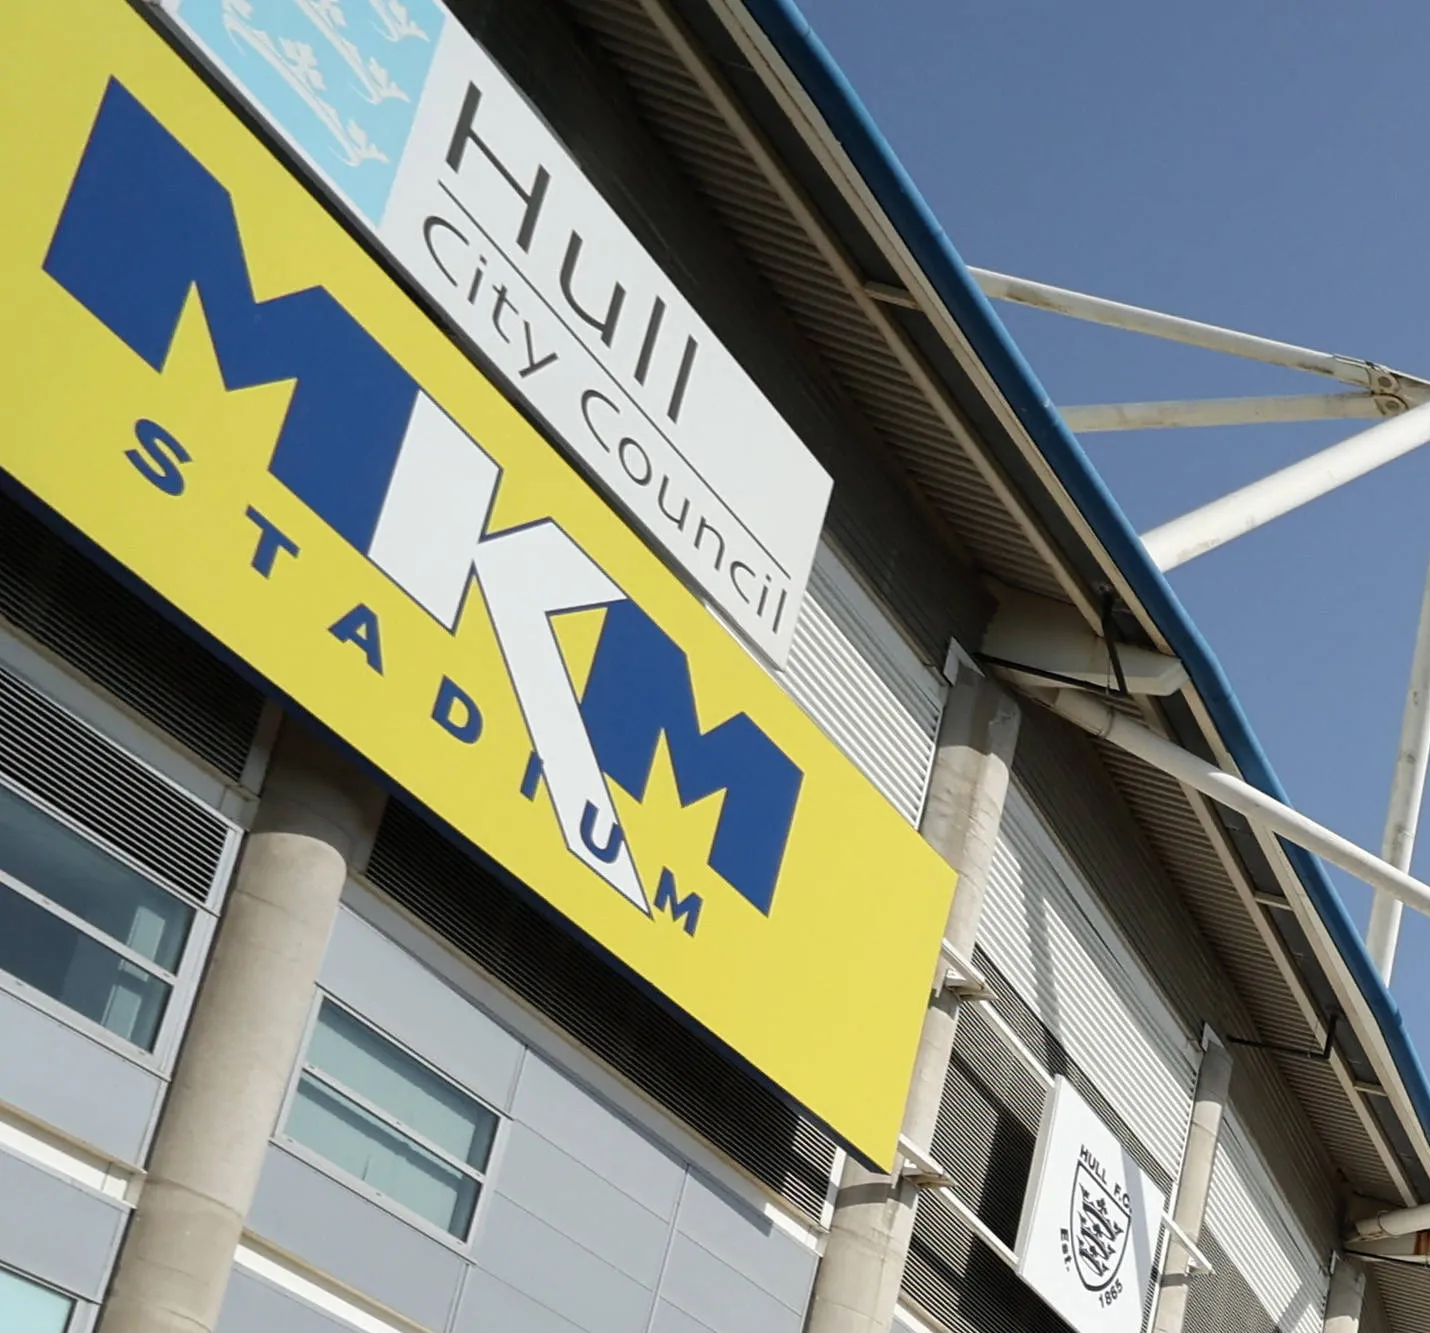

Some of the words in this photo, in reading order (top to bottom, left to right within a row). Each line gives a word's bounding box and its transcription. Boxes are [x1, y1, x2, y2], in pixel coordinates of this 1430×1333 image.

[421, 214, 560, 378] City
[579, 389, 788, 636] Council
[445, 80, 701, 424] Hull
[42, 75, 805, 918] MKM
[124, 417, 703, 938] STADIUM
[1080, 1145, 1108, 1185] HULL
[1113, 1182, 1133, 1214] F.C.
[1099, 1278, 1123, 1308] 1865
